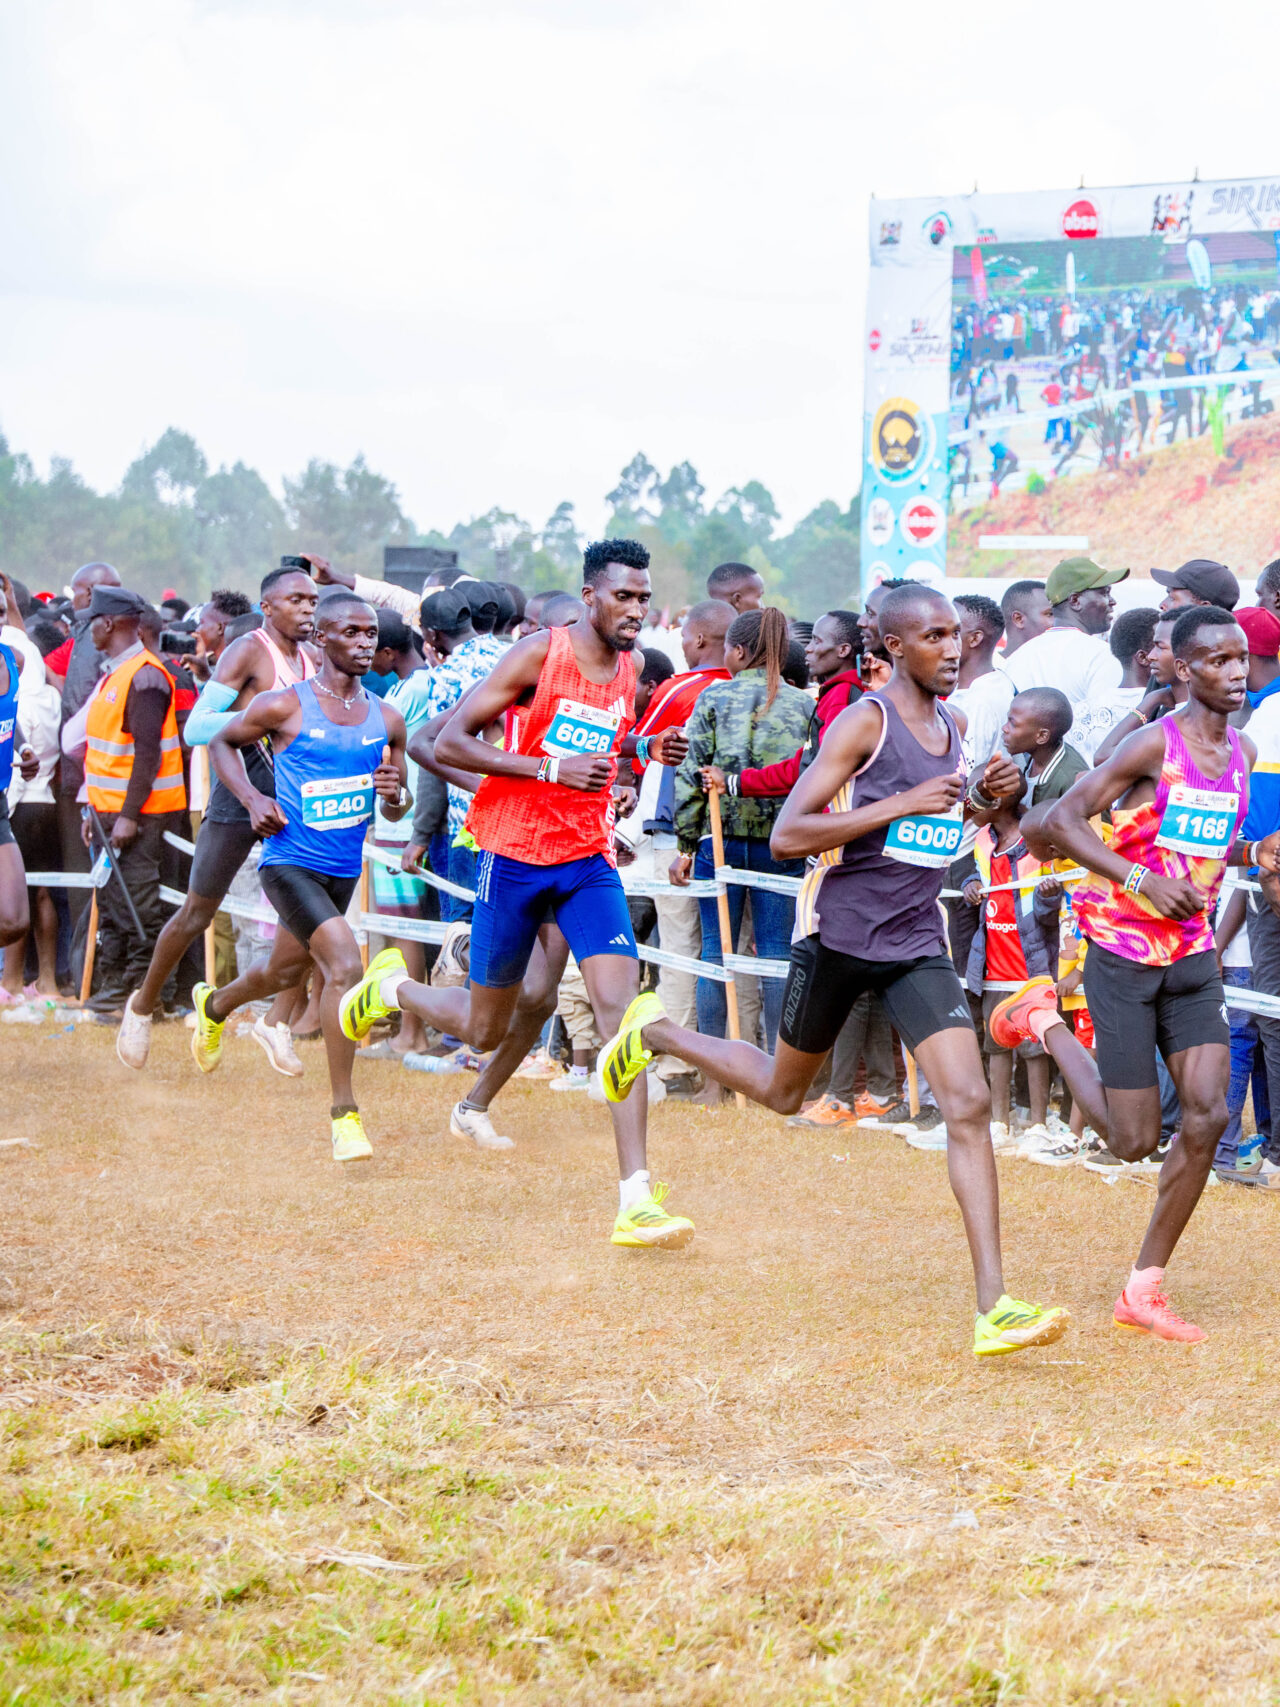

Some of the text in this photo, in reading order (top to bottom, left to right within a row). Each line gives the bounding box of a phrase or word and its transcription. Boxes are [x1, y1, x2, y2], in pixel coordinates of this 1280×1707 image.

[1064, 210, 1097, 230] absa
[556, 722, 611, 753] 6028
[311, 794, 366, 818] 1240
[897, 820, 960, 850] 6008
[1175, 813, 1229, 840] 1168
[783, 967, 807, 1034] ADIZERO
